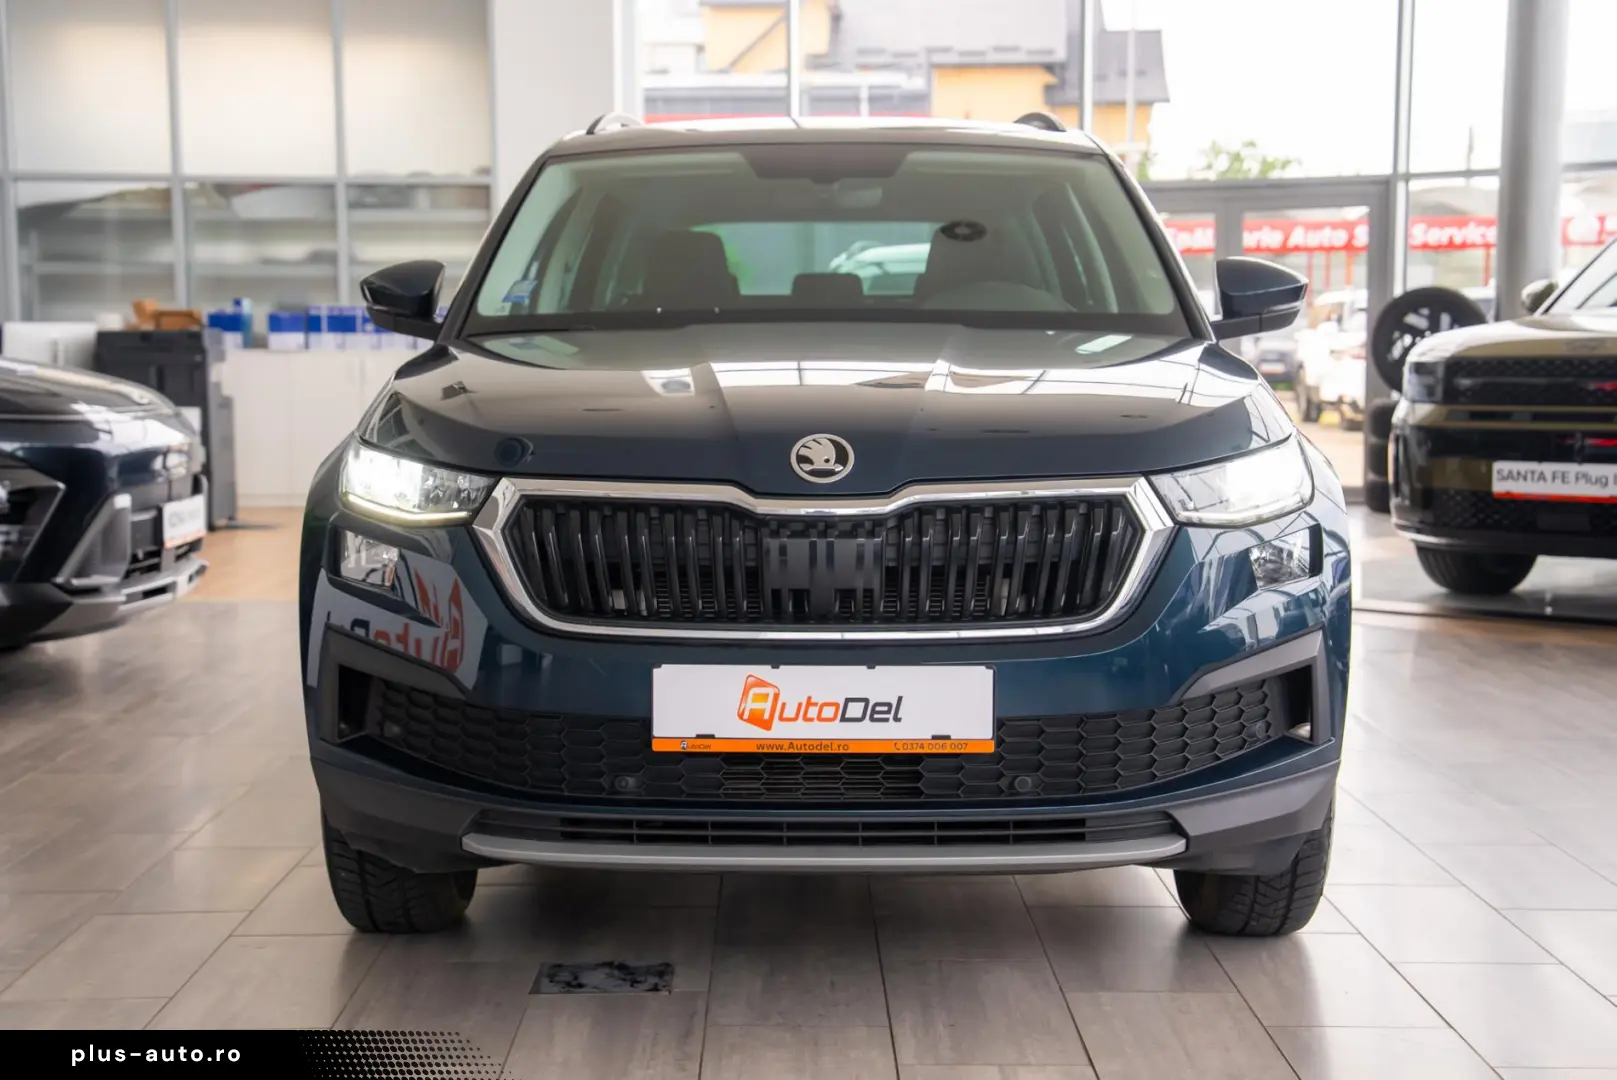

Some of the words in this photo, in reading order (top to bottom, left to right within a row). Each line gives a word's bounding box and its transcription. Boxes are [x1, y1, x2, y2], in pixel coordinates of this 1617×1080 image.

[1286, 224, 1349, 248] Auto
[1496, 468, 1547, 483] SANTA
[1551, 470, 1571, 485] FE
[1575, 471, 1609, 489] Plug
[739, 680, 904, 727] AutoDel
[756, 741, 849, 752] www.Autodel.ro
[902, 742, 925, 751] 0374
[927, 742, 948, 751] 006
[949, 742, 968, 751] 007
